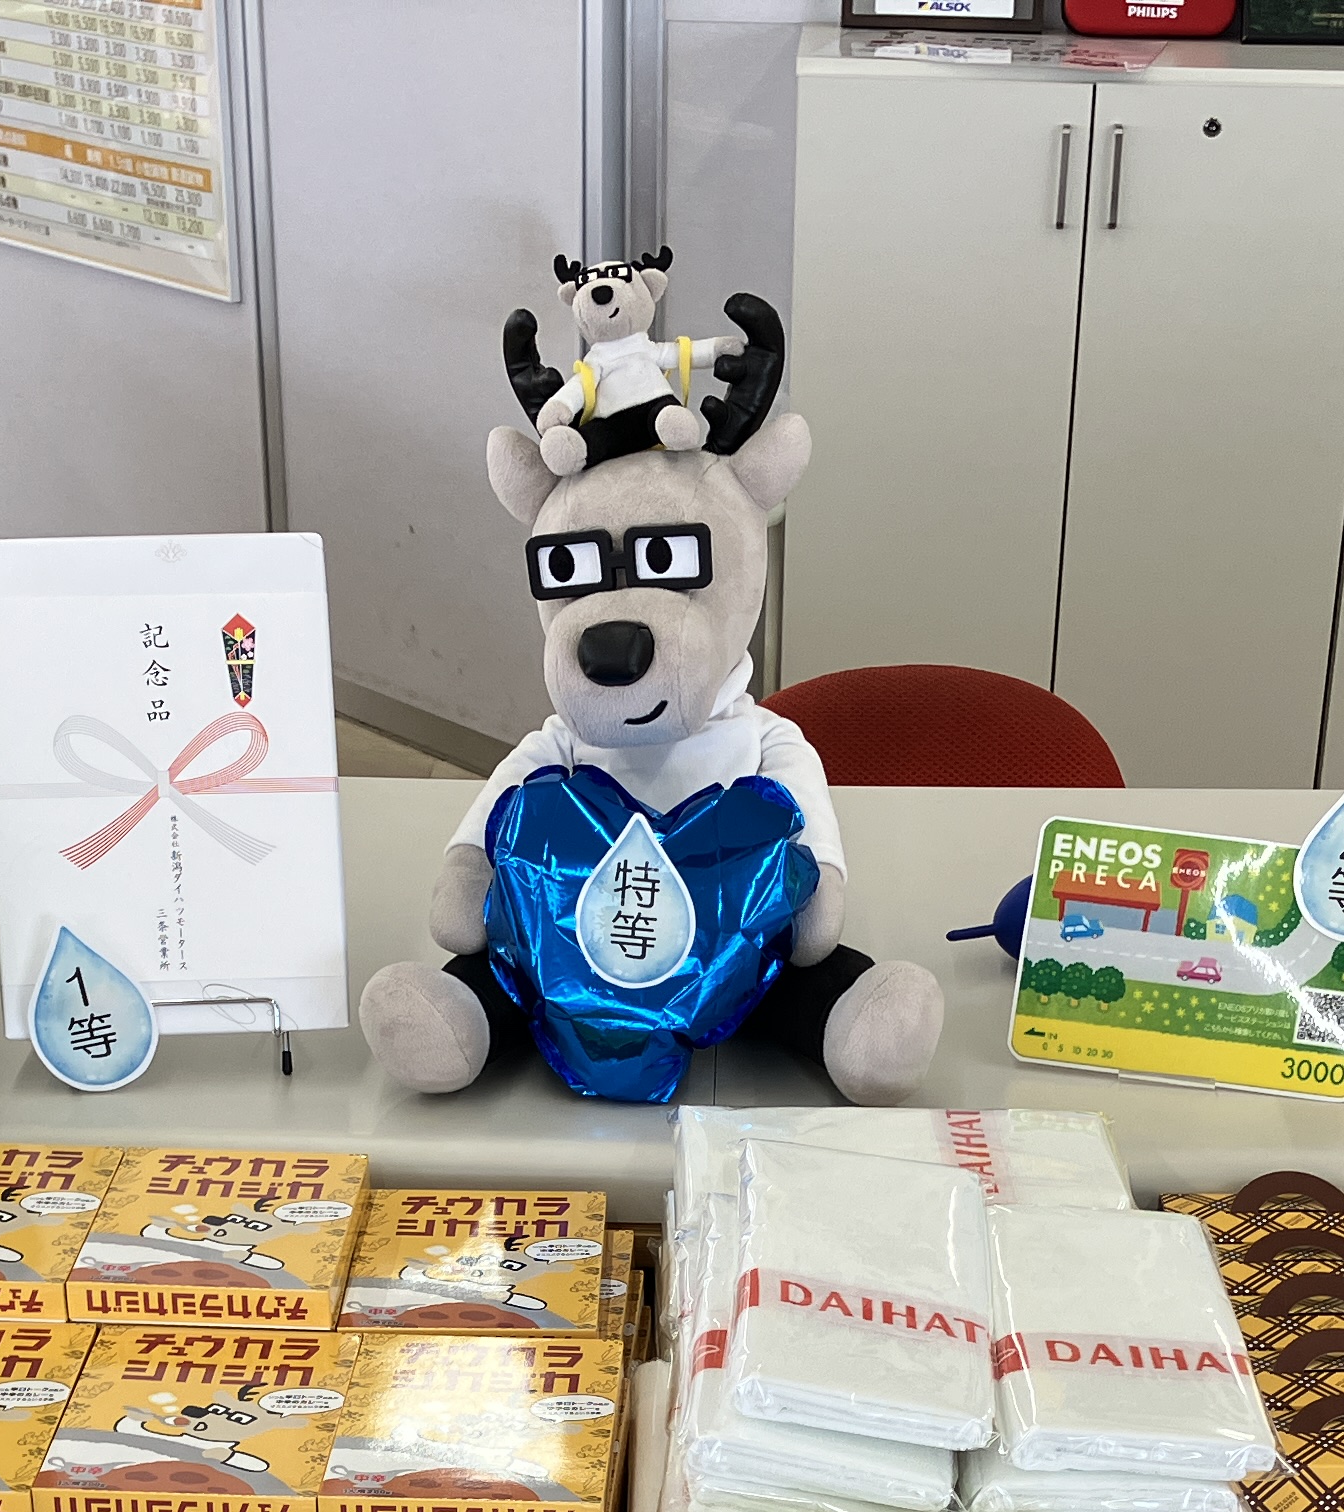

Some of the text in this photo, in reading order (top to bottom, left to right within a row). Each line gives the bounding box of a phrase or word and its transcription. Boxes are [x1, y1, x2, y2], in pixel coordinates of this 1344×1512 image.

[930, 2, 971, 12] ALSOK
[1127, 6, 1178, 18] PHILIPS
[139, 622, 172, 723] 記念品
[1052, 833, 1163, 870] ENEOS
[1048, 859, 1158, 892] PRECA
[1171, 866, 1208, 879] ENEOS
[611, 859, 662, 962] 特等
[156, 908, 171, 971] 三条営業所
[66, 966, 118, 1060] 1等
[1086, 1047, 1098, 1057] 20
[1101, 1049, 1114, 1059] 30
[157, 1154, 329, 1180] チュウカラ
[145, 1176, 325, 1199] シカジカ
[401, 1196, 570, 1216] チュウカラ
[396, 1218, 568, 1239] シカジカ
[87, 1290, 308, 1320] チュウカラシカジカ
[135, 1332, 321, 1360] チュウカラ
[120, 1359, 318, 1387] シカジカ
